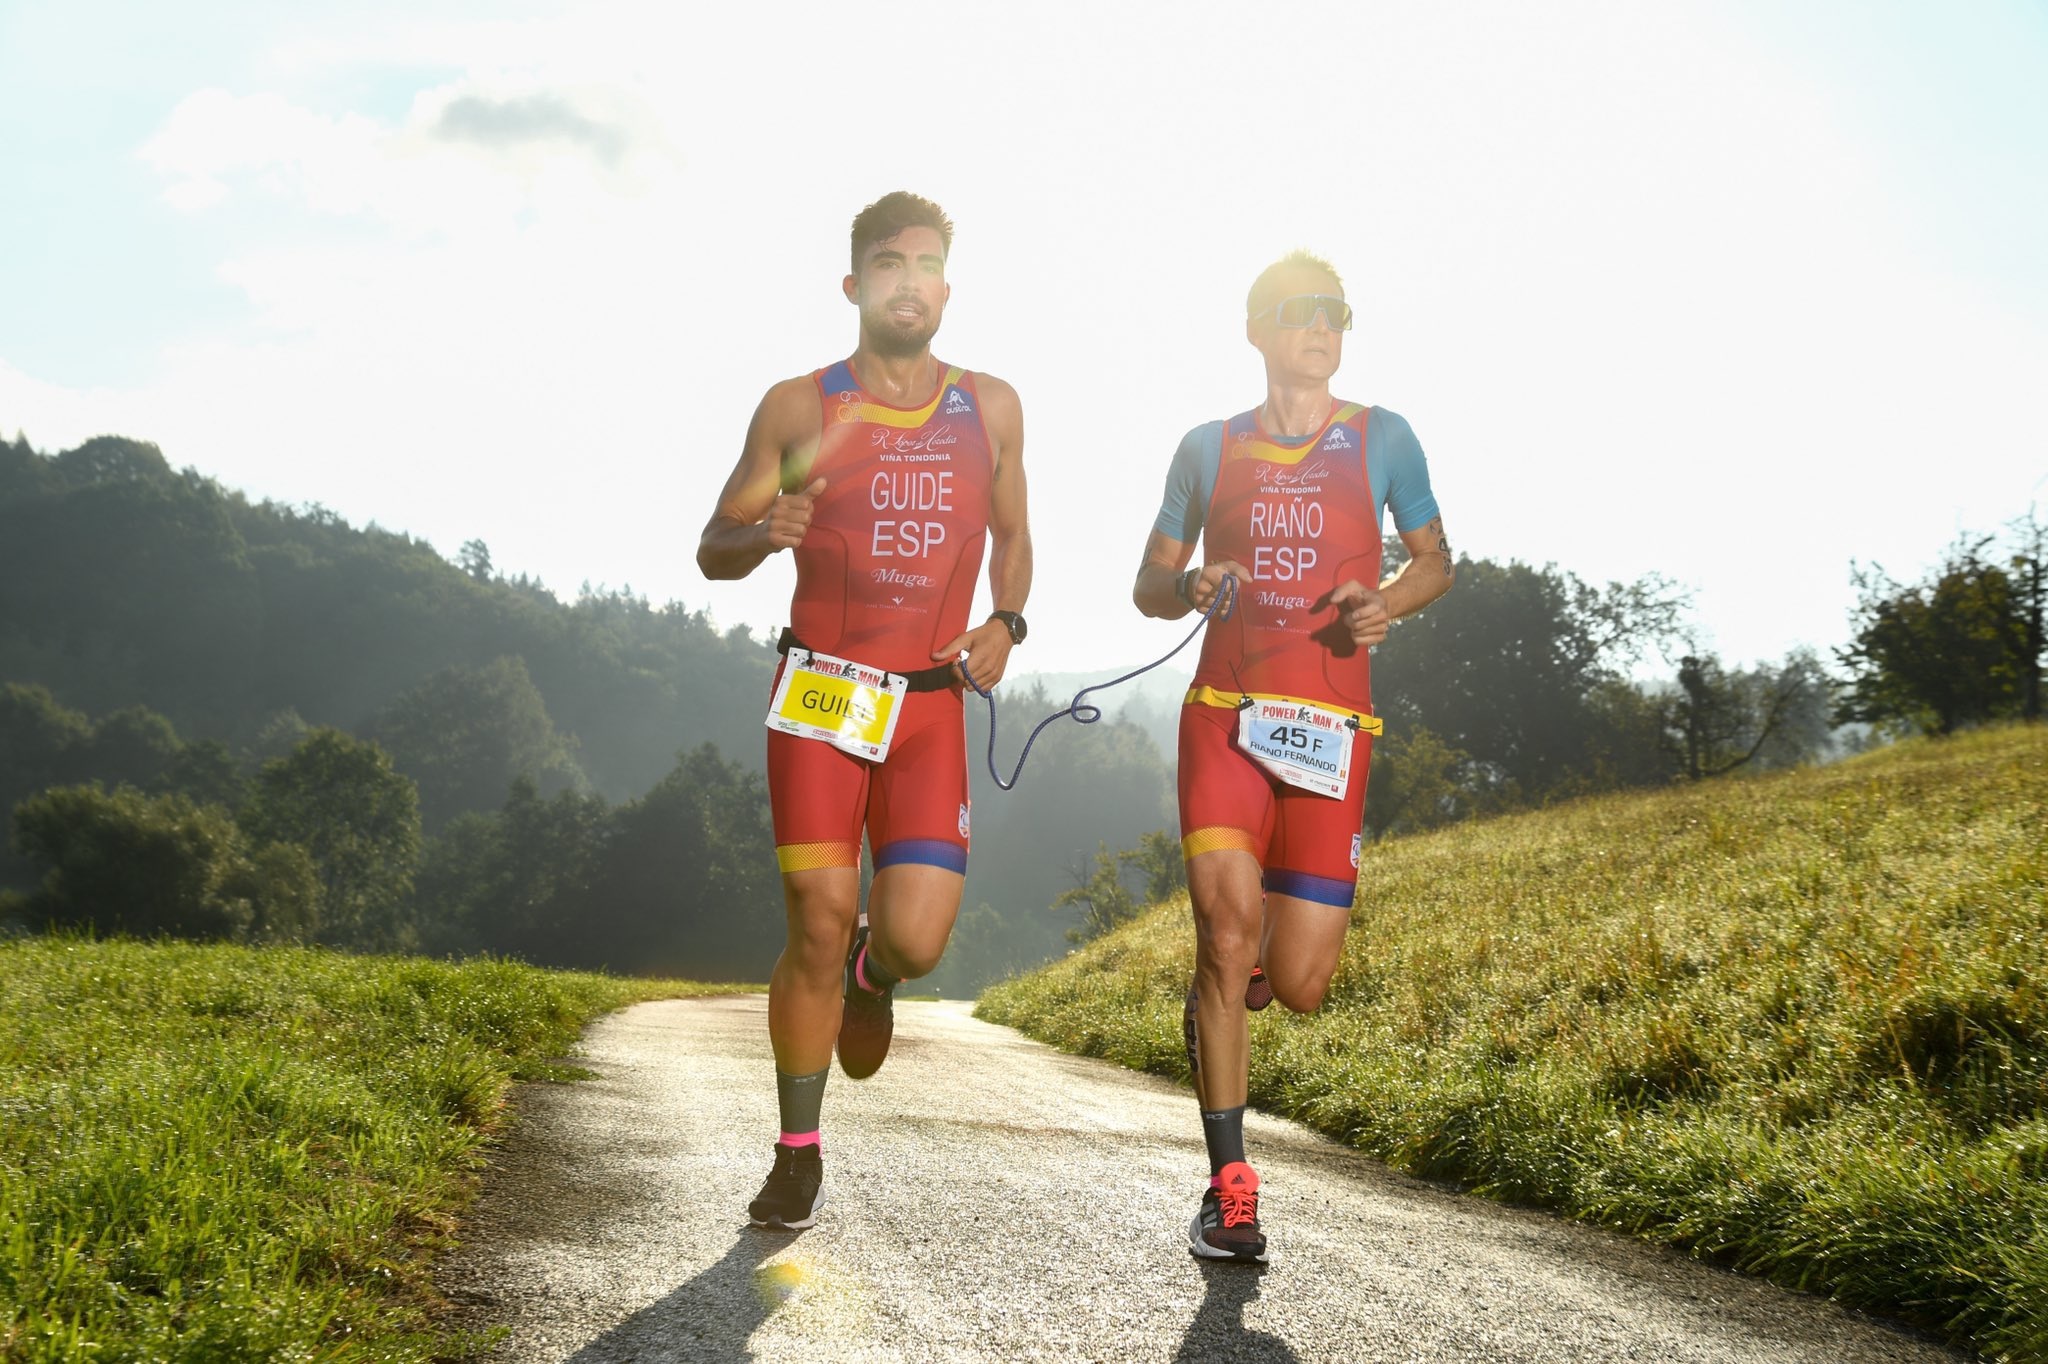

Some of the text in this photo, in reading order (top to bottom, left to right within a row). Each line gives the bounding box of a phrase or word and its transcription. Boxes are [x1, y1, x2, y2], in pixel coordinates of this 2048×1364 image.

[904, 453, 951, 462] TONDONIA
[870, 471, 953, 511] GUIDE
[1281, 486, 1321, 494] TONDONIA
[1250, 496, 1323, 539] RIAÑO
[871, 520, 945, 558] ESP
[1253, 547, 1317, 581] ESP
[871, 568, 936, 587] Muga
[1256, 591, 1313, 609] Muga
[858, 670, 881, 687] MAN
[1262, 705, 1297, 720] POWER
[1312, 713, 1332, 729] MAN
[1269, 726, 1323, 752] 45 F
[1284, 750, 1337, 773] FERNANDO
